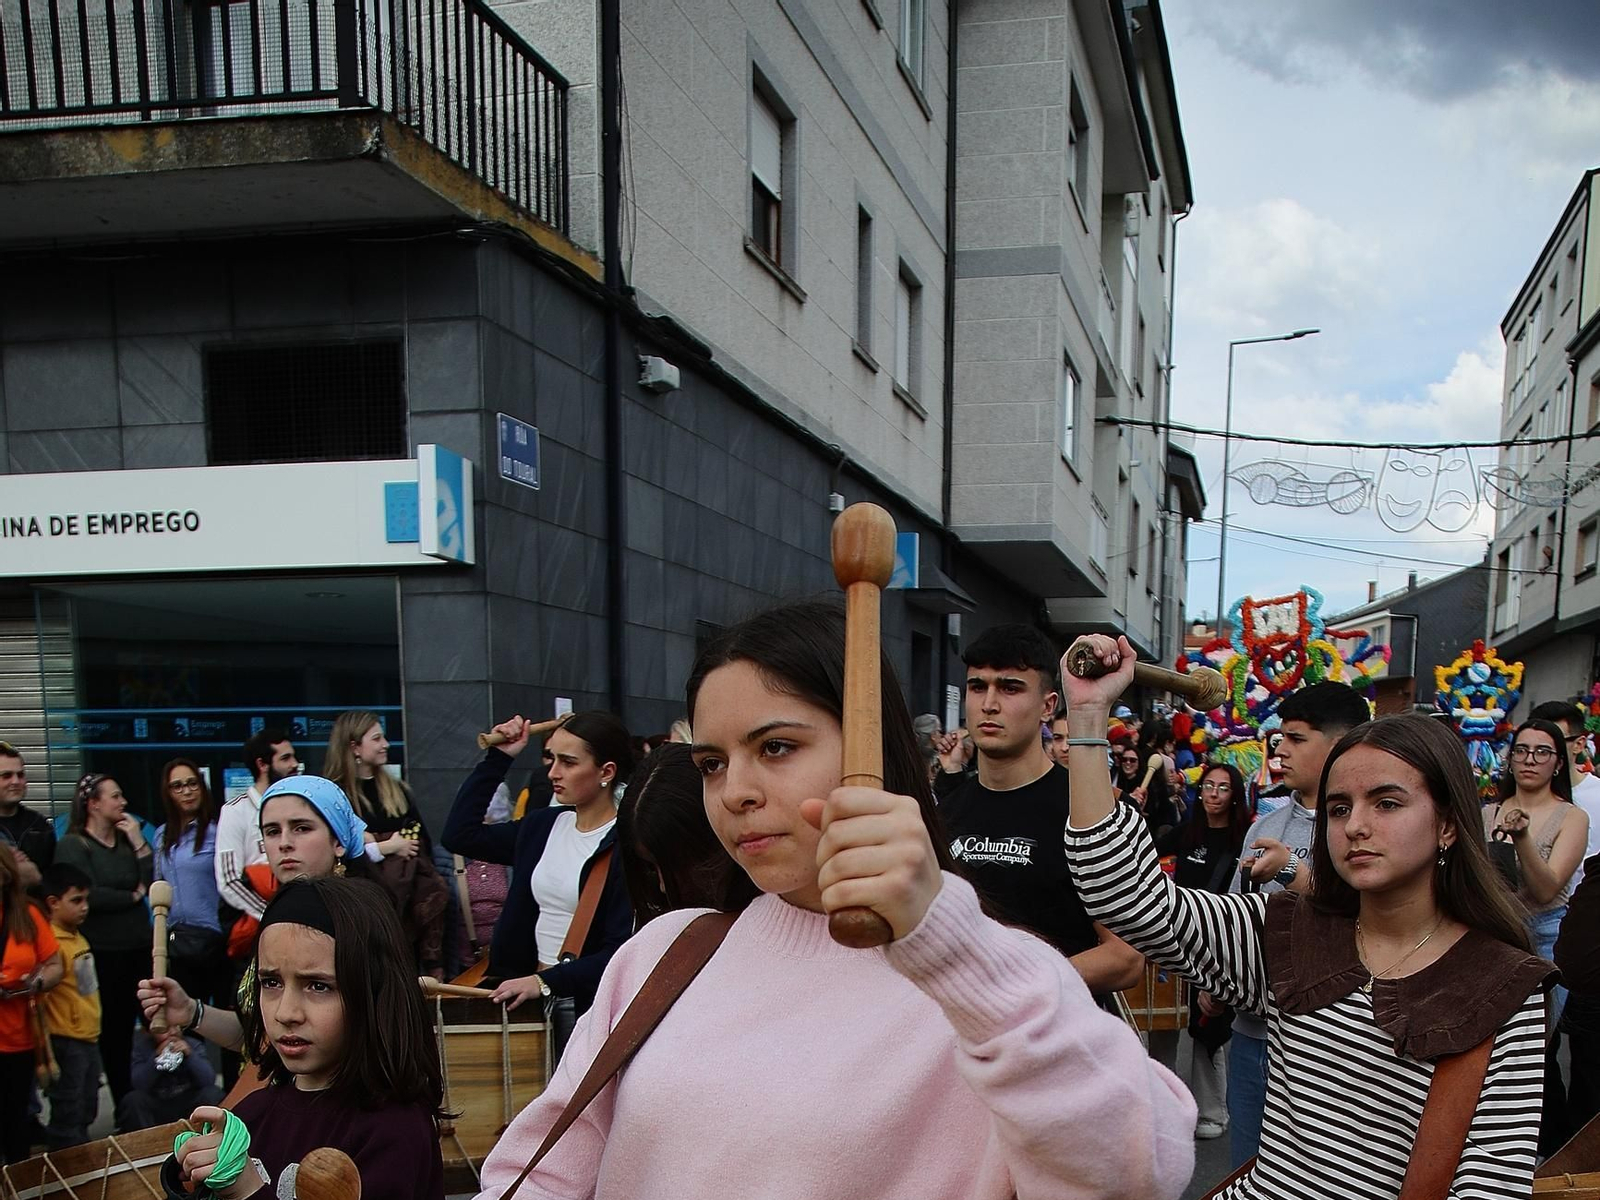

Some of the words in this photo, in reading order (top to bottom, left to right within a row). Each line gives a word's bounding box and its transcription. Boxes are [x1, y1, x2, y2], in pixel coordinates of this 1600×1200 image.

[49, 514, 79, 536] DE
[87, 511, 200, 535] EMPREGO
[964, 837, 1031, 856] Columbia
